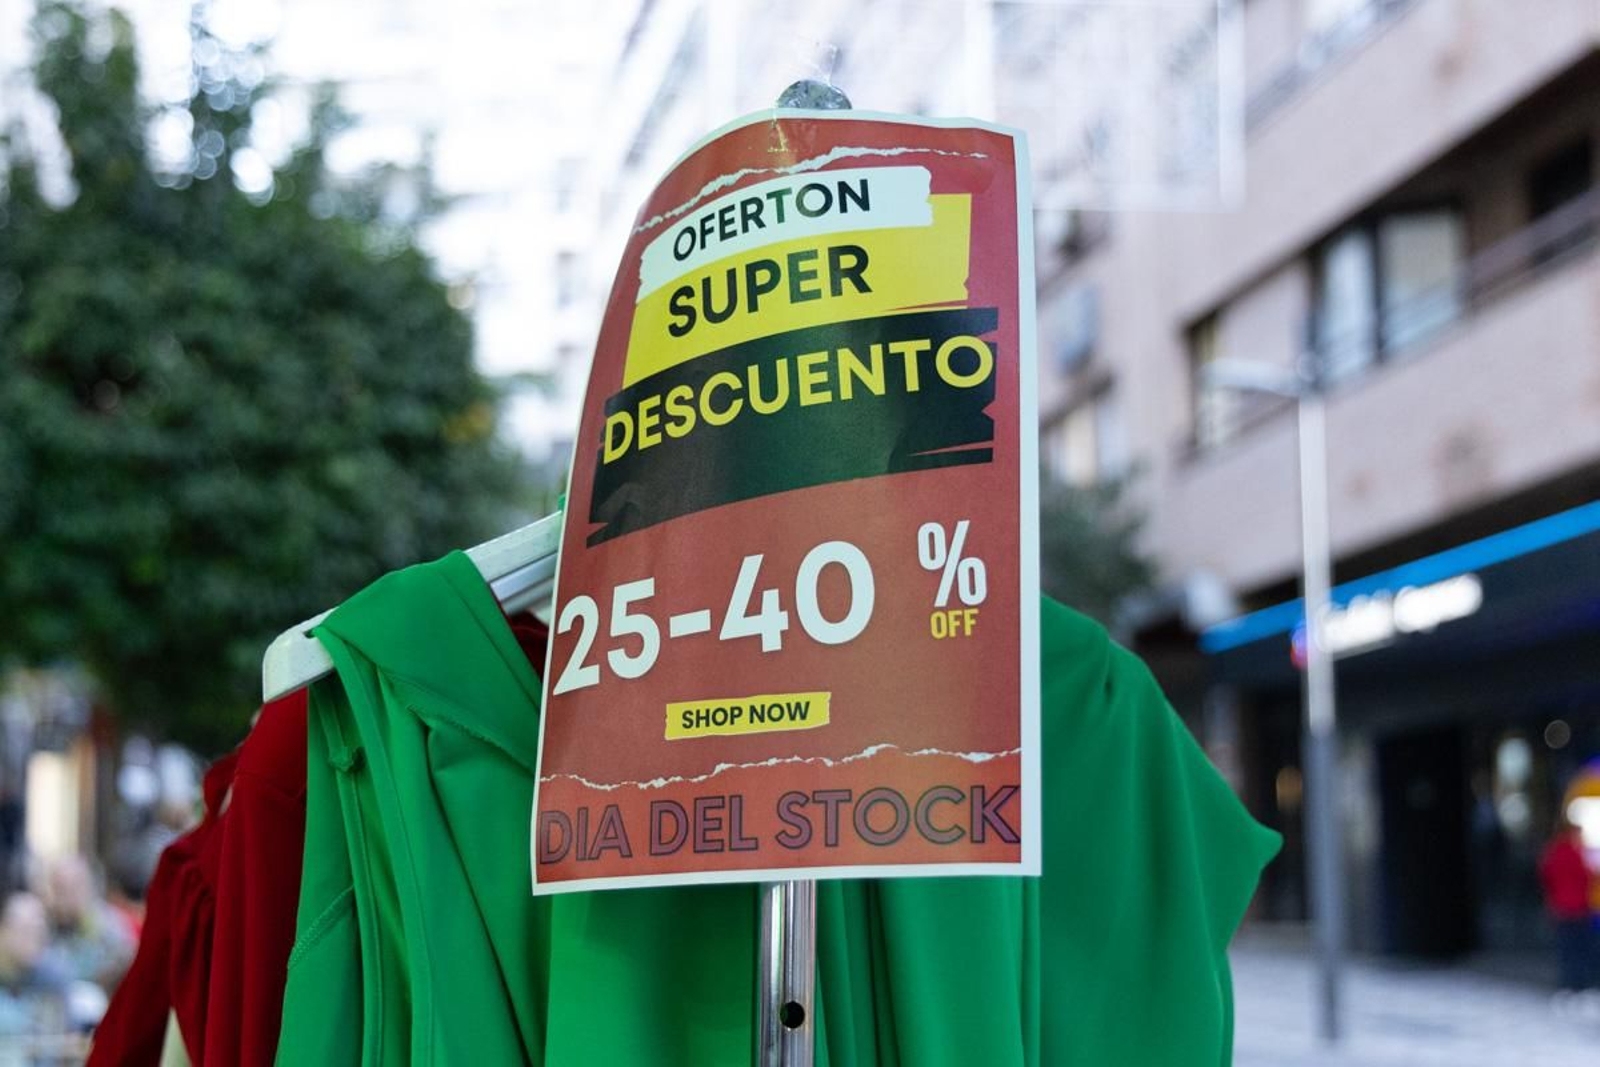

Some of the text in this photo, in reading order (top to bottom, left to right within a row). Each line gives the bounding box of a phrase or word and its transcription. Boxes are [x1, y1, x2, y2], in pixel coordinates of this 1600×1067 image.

[673, 178, 871, 262] OFERTON
[668, 244, 873, 338] SUPER
[603, 335, 994, 465] DESCUENTO
[553, 520, 987, 696] 25-40 %
[930, 608, 979, 640] OFF
[682, 701, 811, 730] SHOP NOW
[539, 784, 1022, 865] DIA DEL STOCK
